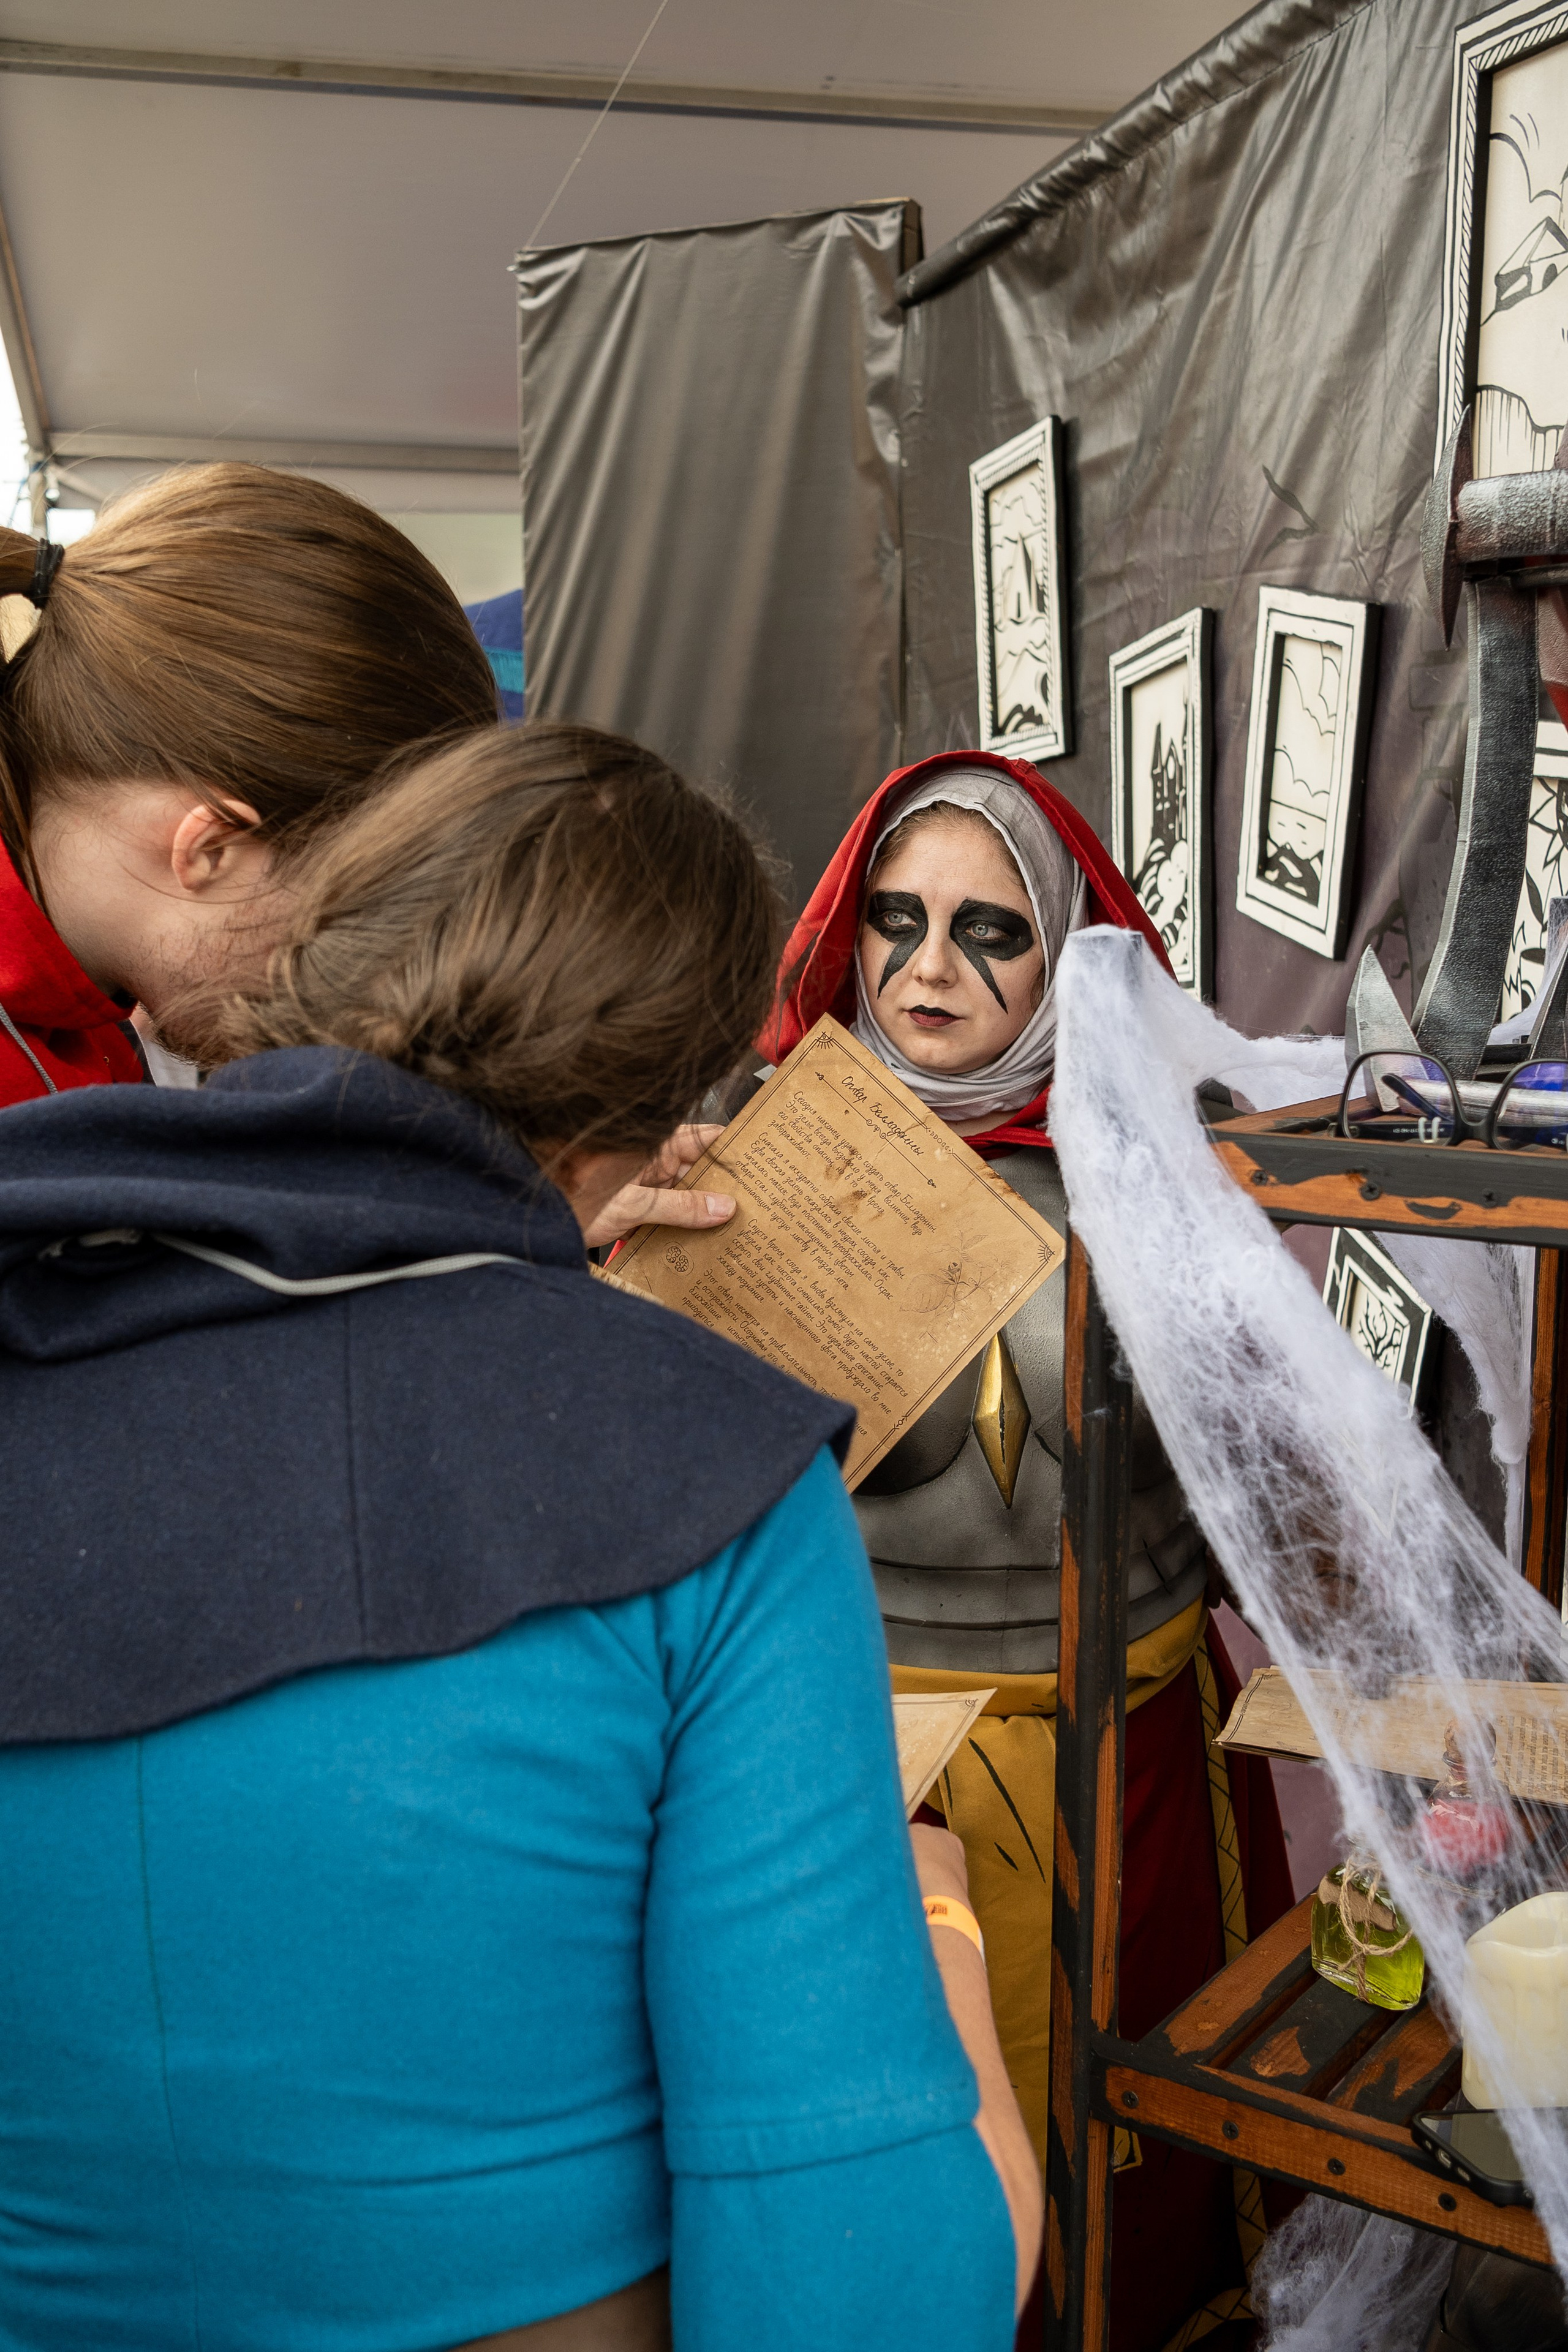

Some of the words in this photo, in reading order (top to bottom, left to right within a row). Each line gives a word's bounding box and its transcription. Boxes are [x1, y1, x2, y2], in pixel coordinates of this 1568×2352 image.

[767, 1119, 810, 1159] завораживают.
[778, 1111, 788, 1120] его
[788, 1118, 812, 1144] свойства
[835, 1166, 845, 1175] но
[850, 1179, 858, 1188] то
[785, 1099, 798, 1113] Это
[813, 1126, 831, 1146] всегда
[831, 1143, 859, 1173] вызывало
[865, 1180, 881, 1194] меня
[883, 1194, 910, 1224] волнение,
[910, 1221, 922, 1235] ведь
[793, 1091, 816, 1115] Сегодня
[816, 1115, 840, 1140] наконец
[839, 1139, 862, 1160] удалось
[863, 1161, 883, 1181] создать
[884, 1181, 901, 1198] отвар
[841, 1076, 867, 1103] Отвар
[869, 1102, 924, 1156] Белладонны
[735, 1161, 755, 1179] отвара
[755, 1179, 768, 1193] стал
[834, 1258, 854, 1277] цветом
[742, 1152, 768, 1177] началась
[768, 1177, 788, 1195] магия:
[788, 1193, 801, 1209] вода
[801, 1209, 832, 1238] постепенно
[831, 1239, 872, 1281] преображалась.
[873, 1279, 893, 1300] Окрас
[750, 1140, 766, 1157] Едва
[765, 1156, 785, 1177] свежая
[782, 1176, 803, 1195] зелень
[804, 1195, 832, 1223] оказалась
[837, 1229, 857, 1248] недрах
[857, 1248, 876, 1269] сосуда,
[877, 1268, 890, 1281] как
[758, 1132, 783, 1158] Сначала
[788, 1165, 818, 1193] аккуратно
[818, 1193, 841, 1216] собрала
[842, 1215, 861, 1235] свежие
[860, 1237, 881, 1254] листья
[769, 1212, 790, 1231] густую
[790, 1233, 812, 1252] листву
[812, 1256, 835, 1276] разгар
[682, 1297, 714, 1327] пригодиться
[688, 1285, 721, 1320] ближайшие
[702, 1286, 738, 1322] осторожности.
[739, 1321, 771, 1351] Осознавая
[716, 1255, 736, 1276] жажду
[732, 1238, 751, 1258] скрыть
[752, 1257, 765, 1271] свои
[765, 1271, 796, 1301] глубинные
[815, 1319, 827, 1333] Это
[827, 1334, 855, 1362] идеальное
[736, 1229, 761, 1253] увидела,
[763, 1253, 775, 1265] как
[776, 1265, 796, 1286] чистота
[796, 1287, 824, 1314] сменилась
[825, 1314, 845, 1334] тьмой,
[842, 1330, 859, 1349] будто
[859, 1350, 882, 1370] настой
[880, 1371, 908, 1397] старается
[748, 1218, 767, 1240] Спустя
[766, 1238, 784, 1259] время,
[785, 1258, 801, 1275] когда
[810, 1280, 827, 1298] вновь
[824, 1296, 854, 1327] взглянула
[854, 1327, 863, 1336] на
[863, 1337, 878, 1351] само
[875, 1351, 894, 1370] зелье,
[703, 1268, 718, 1284] Этот
[717, 1285, 733, 1303] отвар,
[734, 1302, 760, 1327] несмотря
[760, 1327, 769, 1336] на
[768, 1336, 816, 1387] привлекательность,
[724, 1246, 758, 1278] правильной
[755, 1278, 778, 1300] густоты
[783, 1306, 821, 1343] насыщенного
[820, 1344, 837, 1360] цвета
[837, 1360, 870, 1393] пробуждало
[870, 1392, 880, 1401] во
[878, 1402, 891, 1414] мне
